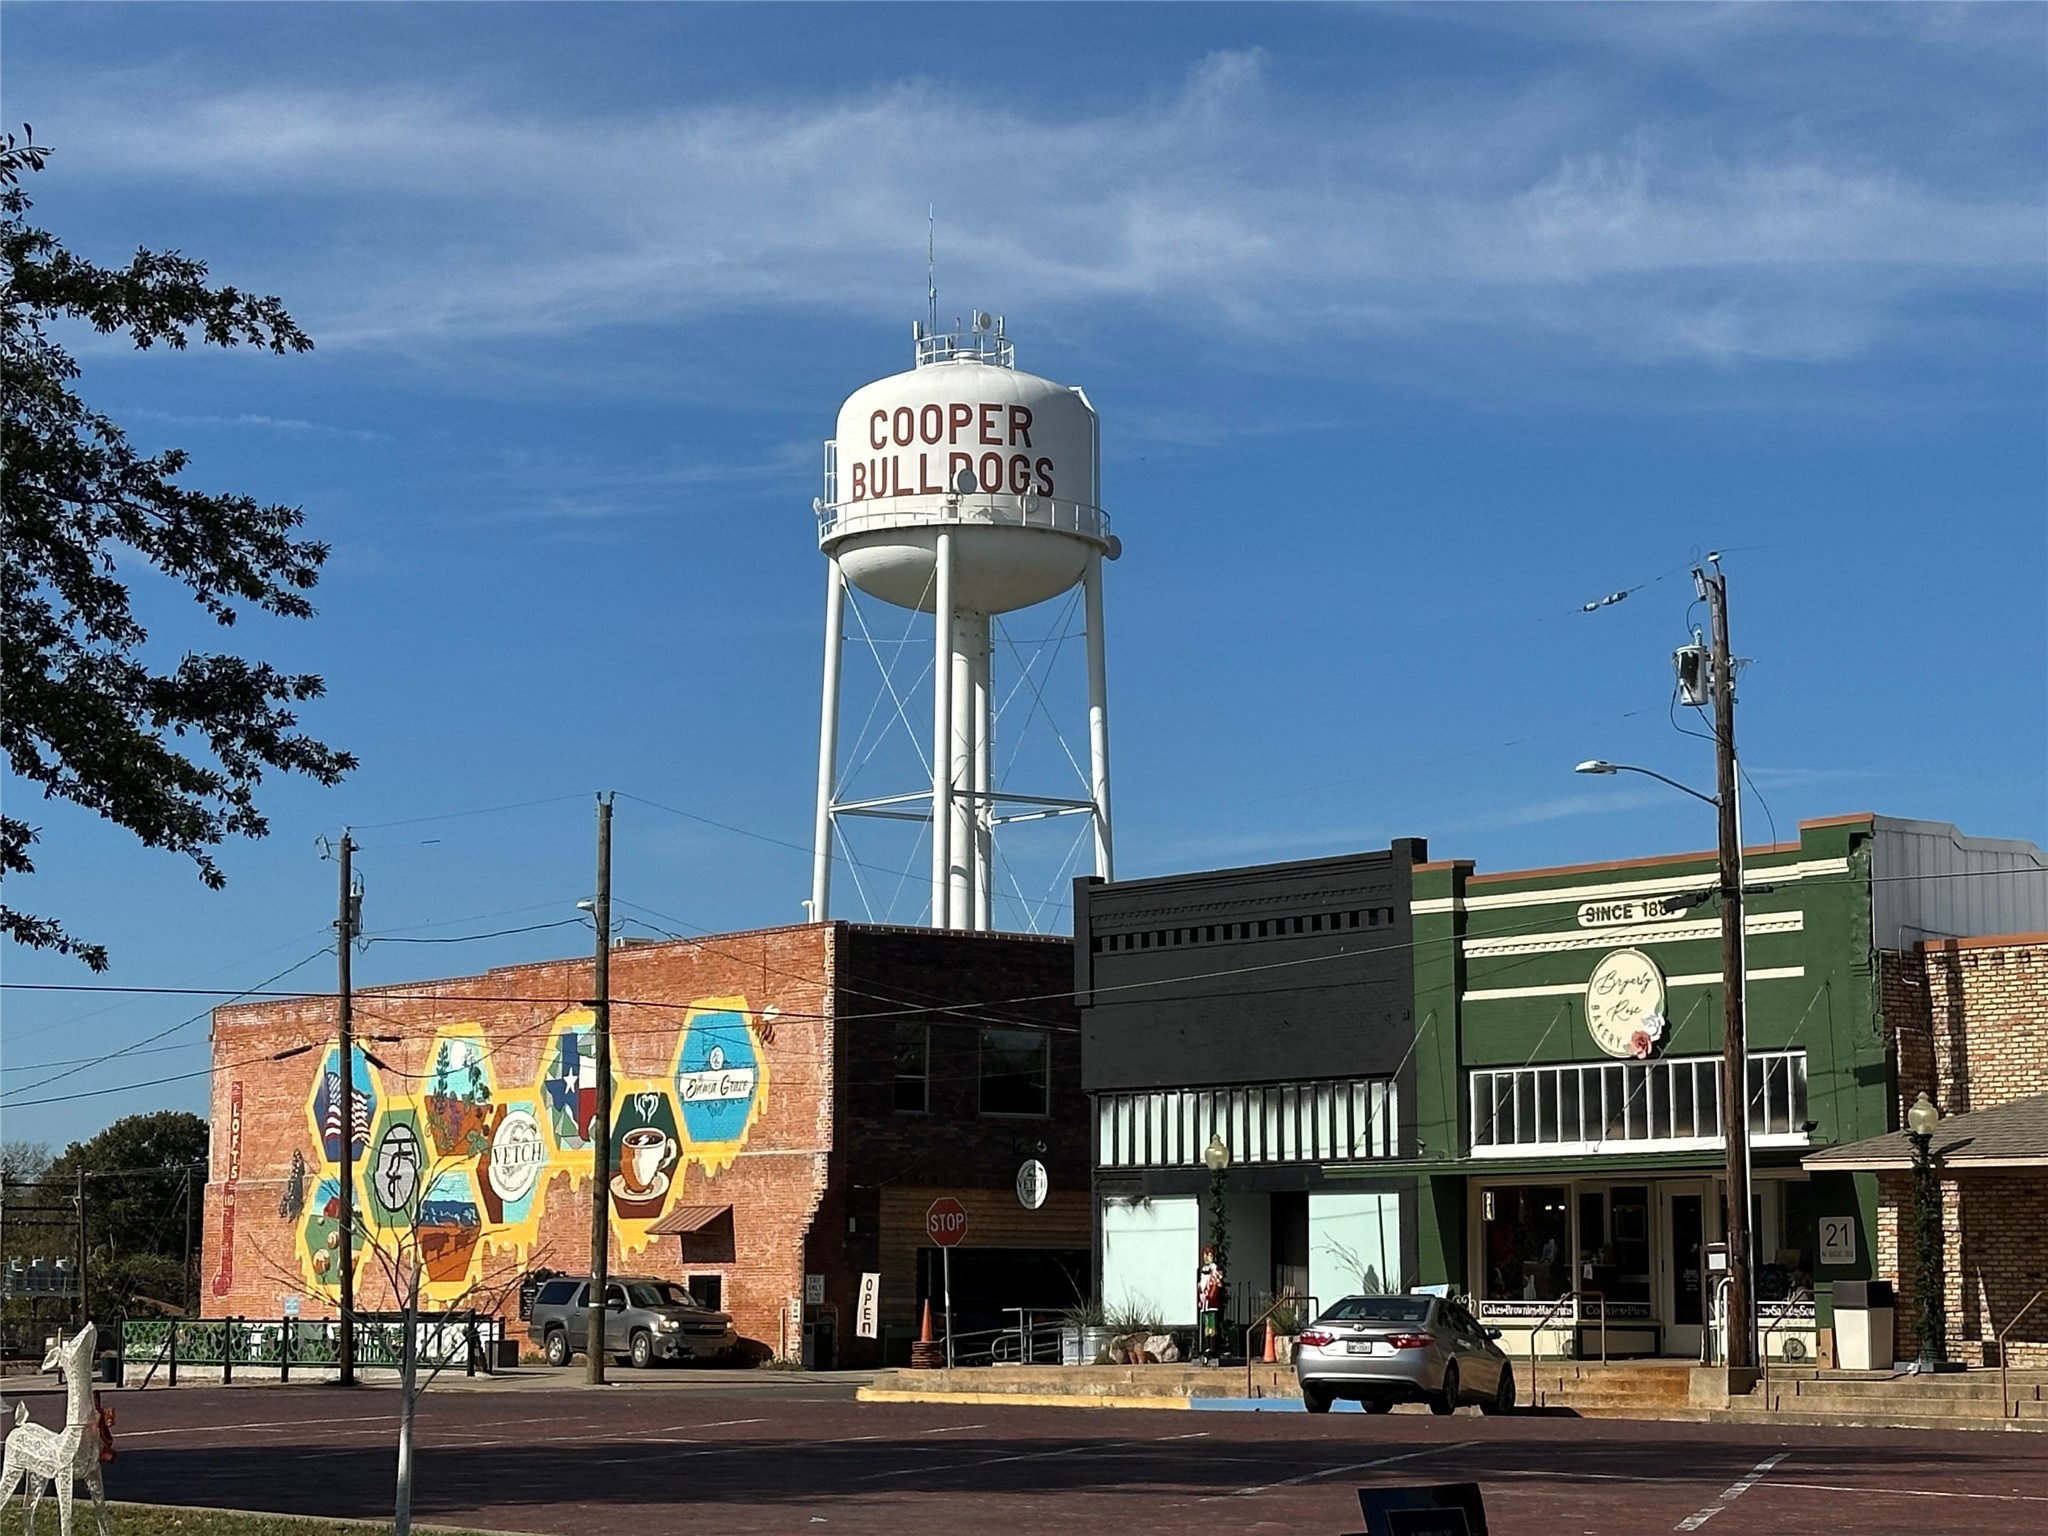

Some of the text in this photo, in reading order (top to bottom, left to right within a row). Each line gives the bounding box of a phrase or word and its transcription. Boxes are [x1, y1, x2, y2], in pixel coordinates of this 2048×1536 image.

[870, 403, 1033, 450] COOPER
[852, 451, 1055, 500] BULLDOGS
[1585, 903, 1633, 923] SINCE
[1606, 999, 1642, 1022] Rose
[1591, 1004, 1622, 1049] BAKERY
[686, 1078, 718, 1099] Emma
[720, 1074, 749, 1096] Grace
[230, 1102, 240, 1180] LOFTS
[493, 1142, 542, 1165] VETCH
[930, 1213, 965, 1232] STOP
[1825, 1223, 1848, 1247] 21
